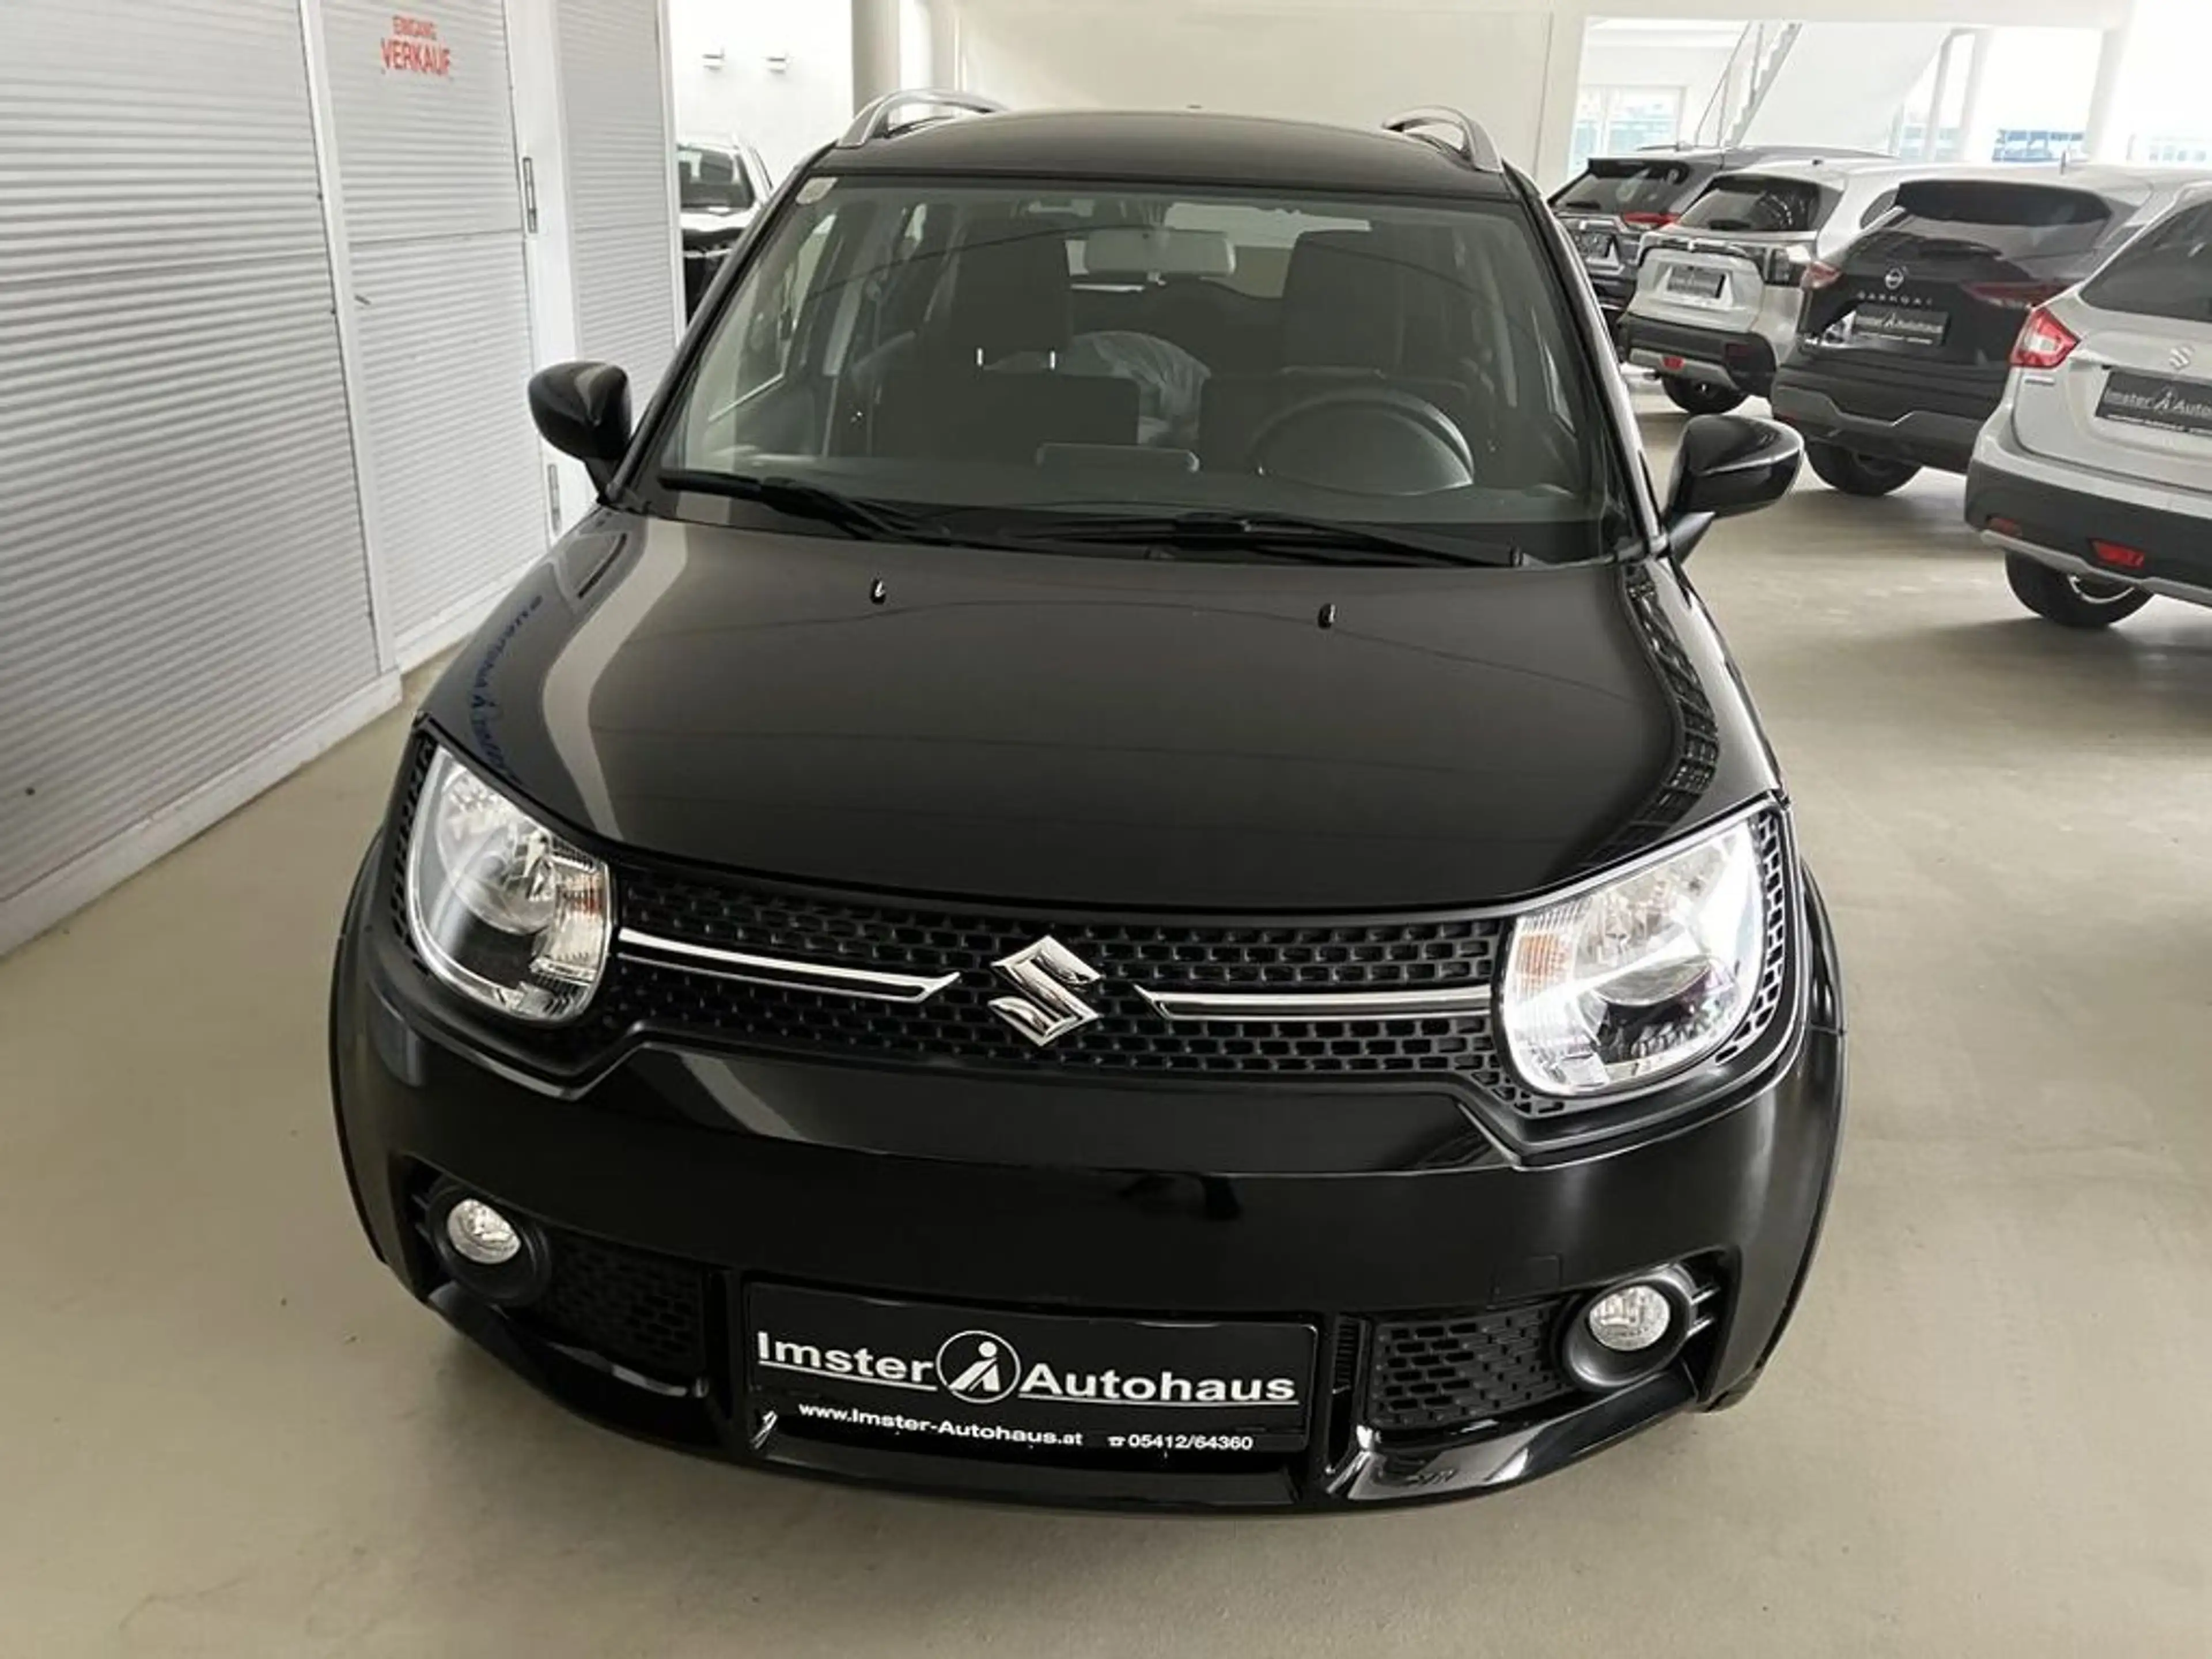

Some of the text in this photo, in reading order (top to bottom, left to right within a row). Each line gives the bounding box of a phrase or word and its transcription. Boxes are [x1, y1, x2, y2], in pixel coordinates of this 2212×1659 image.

[381, 37, 450, 75] VERKAUF
[757, 1331, 1296, 1402] Imster Autohaus
[798, 1403, 1253, 1450] www.Imster-Autohaus.at 05412/64360
